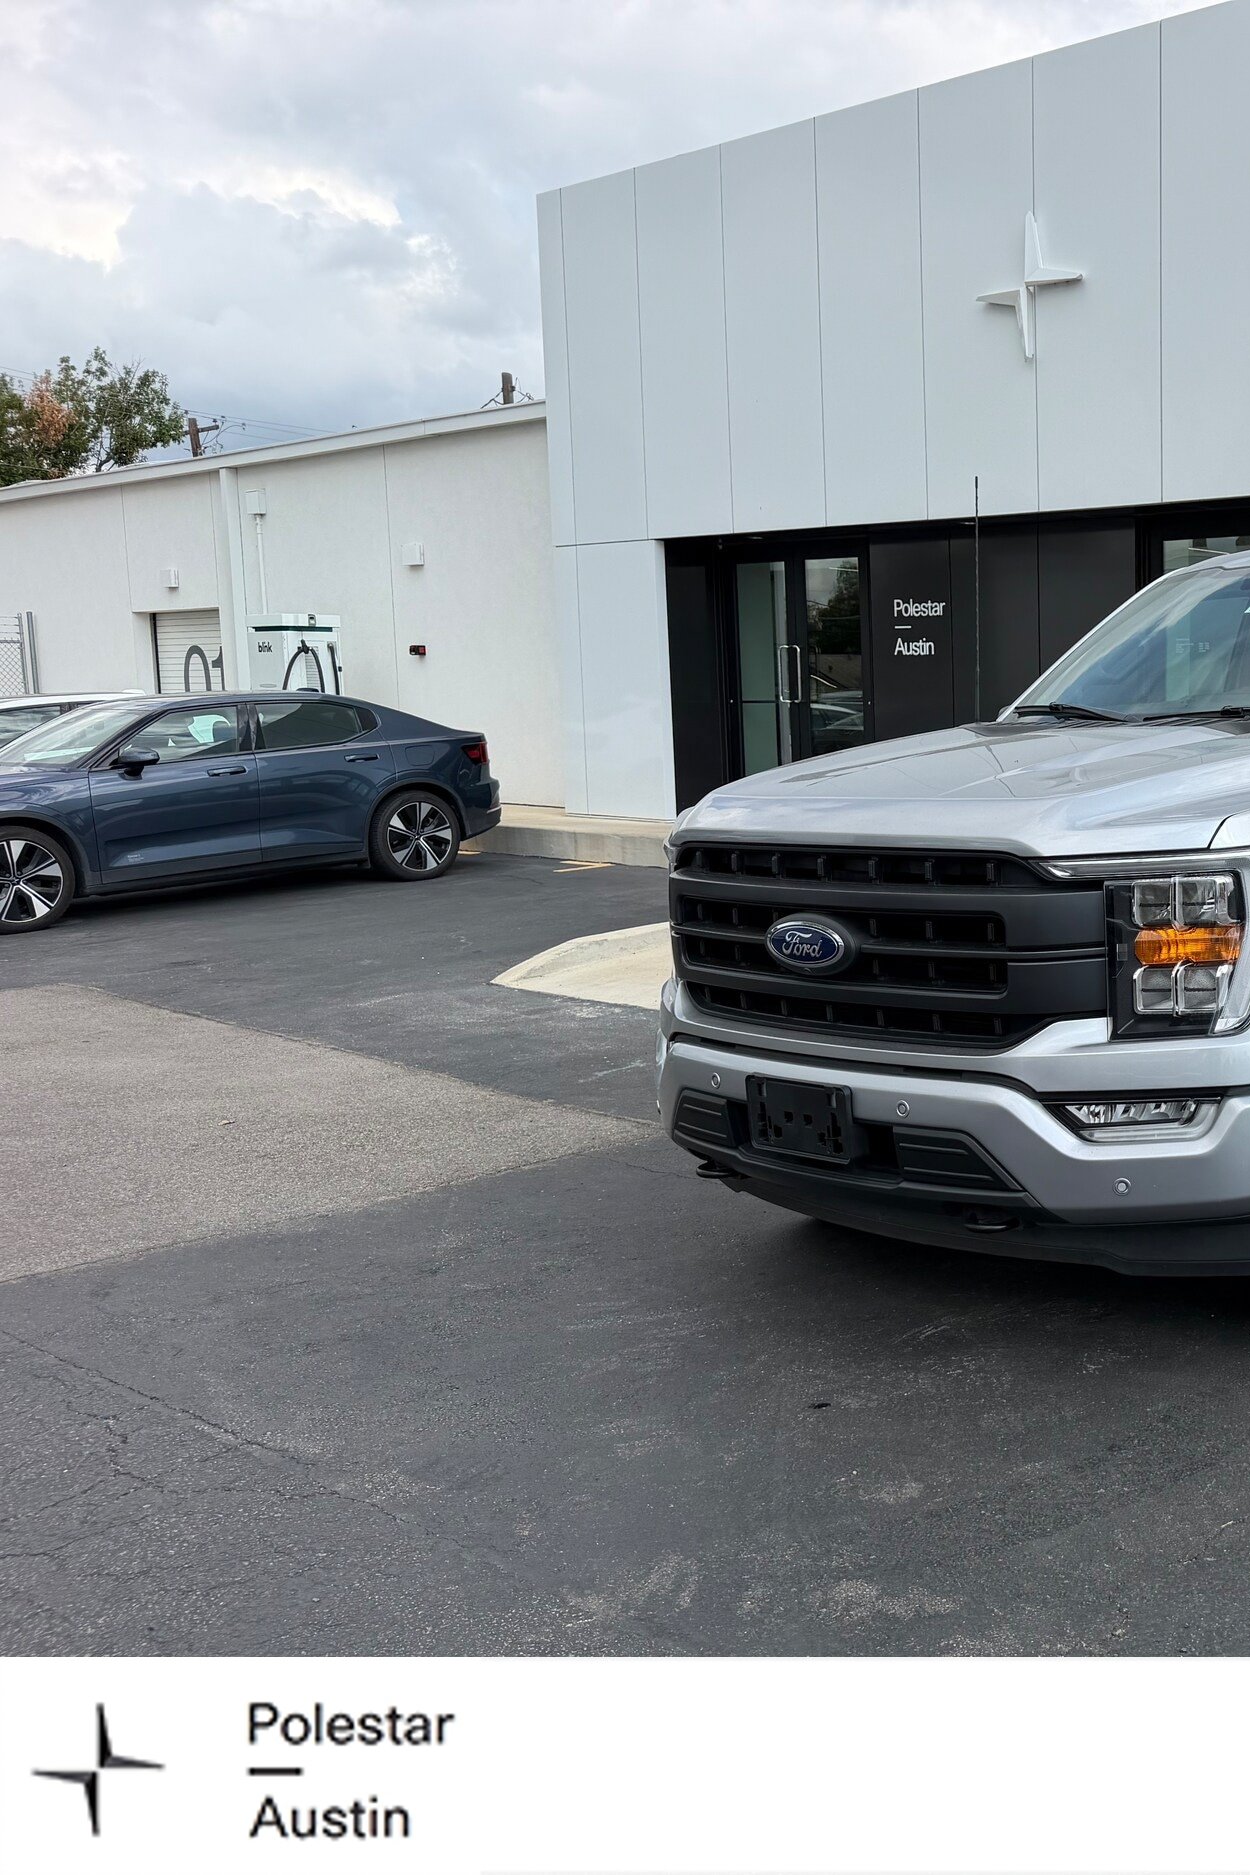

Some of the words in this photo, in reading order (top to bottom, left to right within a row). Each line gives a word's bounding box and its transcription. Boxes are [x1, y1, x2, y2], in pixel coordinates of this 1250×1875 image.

[893, 598, 946, 617] Polestar
[257, 641, 273, 653] blink
[894, 637, 935, 656] Austin
[782, 930, 823, 957] Ford
